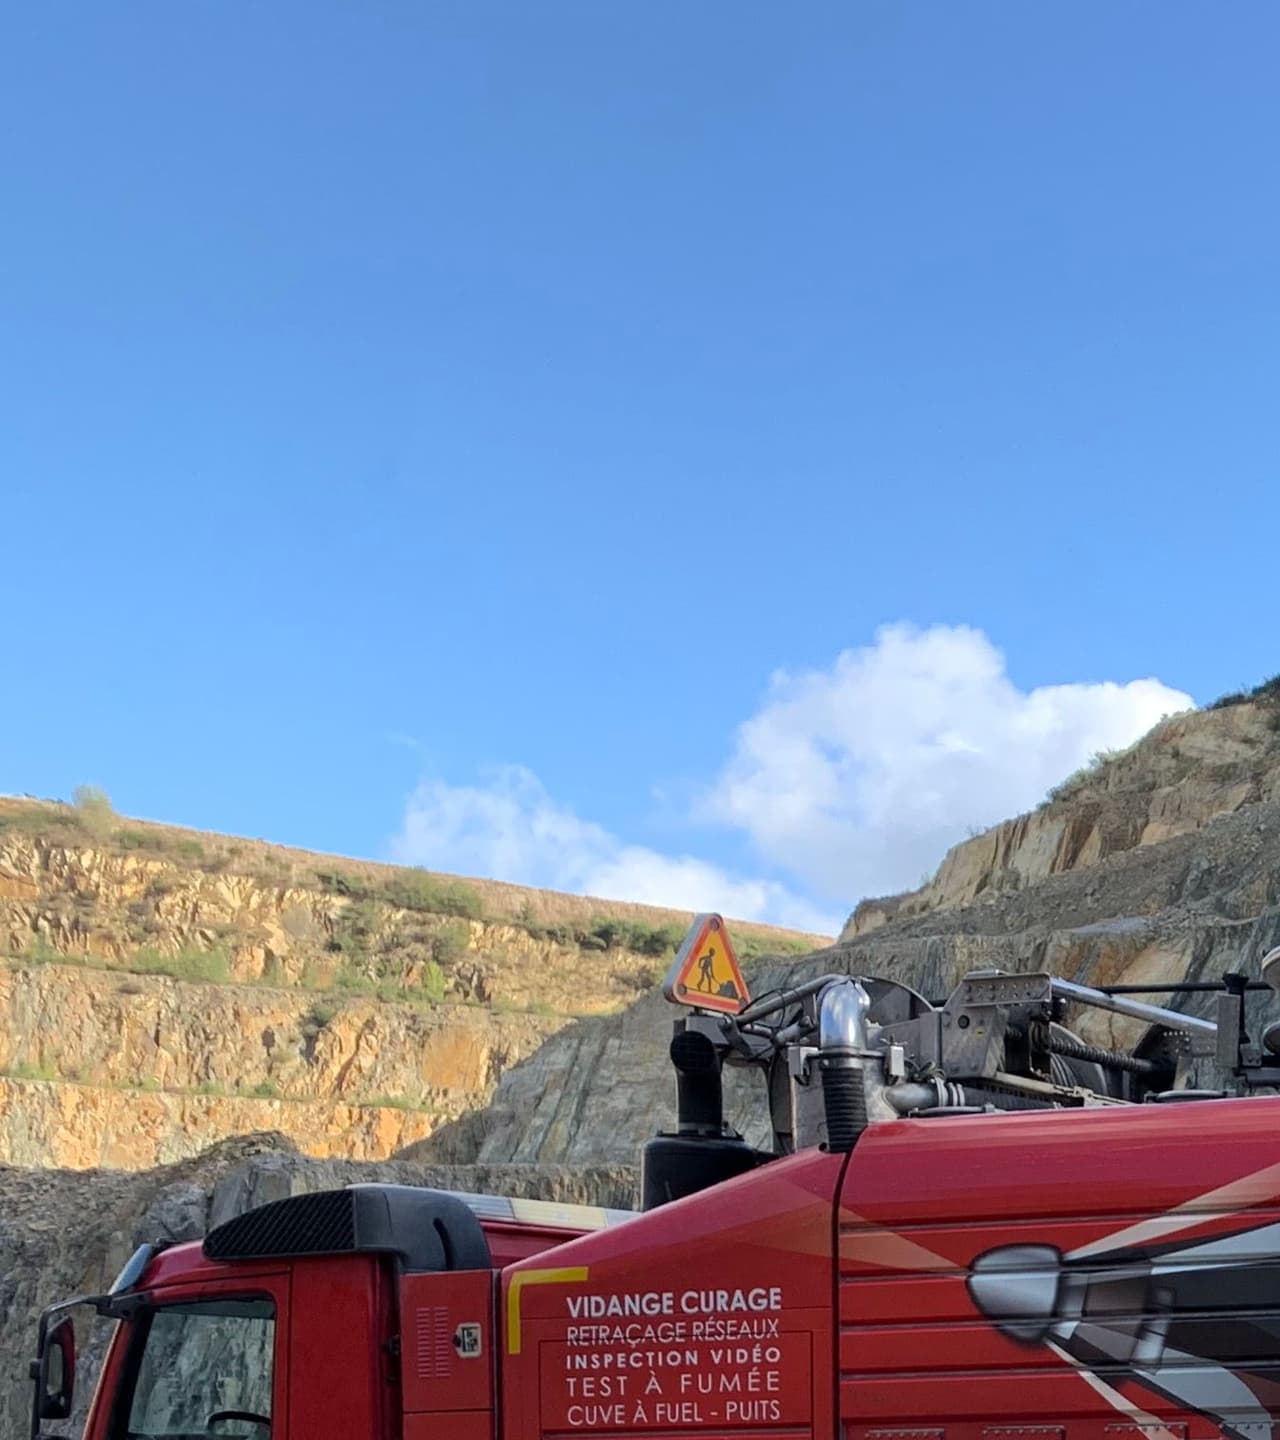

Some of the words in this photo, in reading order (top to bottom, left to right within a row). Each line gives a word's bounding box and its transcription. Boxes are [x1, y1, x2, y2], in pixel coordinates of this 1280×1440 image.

[566, 1293, 674, 1318] VIDANGE
[680, 1287, 782, 1314] CURAGE
[567, 1322, 686, 1348] RETRAÇAGE
[692, 1316, 779, 1342] RÉSEAUX
[566, 1350, 698, 1370] INSPECTION
[710, 1344, 781, 1365] VIDÉO
[566, 1375, 628, 1398] TEST
[644, 1370, 663, 1395] À
[680, 1367, 780, 1394] FUMÉE
[567, 1404, 625, 1426] CUVE
[632, 1400, 648, 1424] À
[656, 1403, 703, 1423] FUEL
[726, 1400, 781, 1421] PUITS
